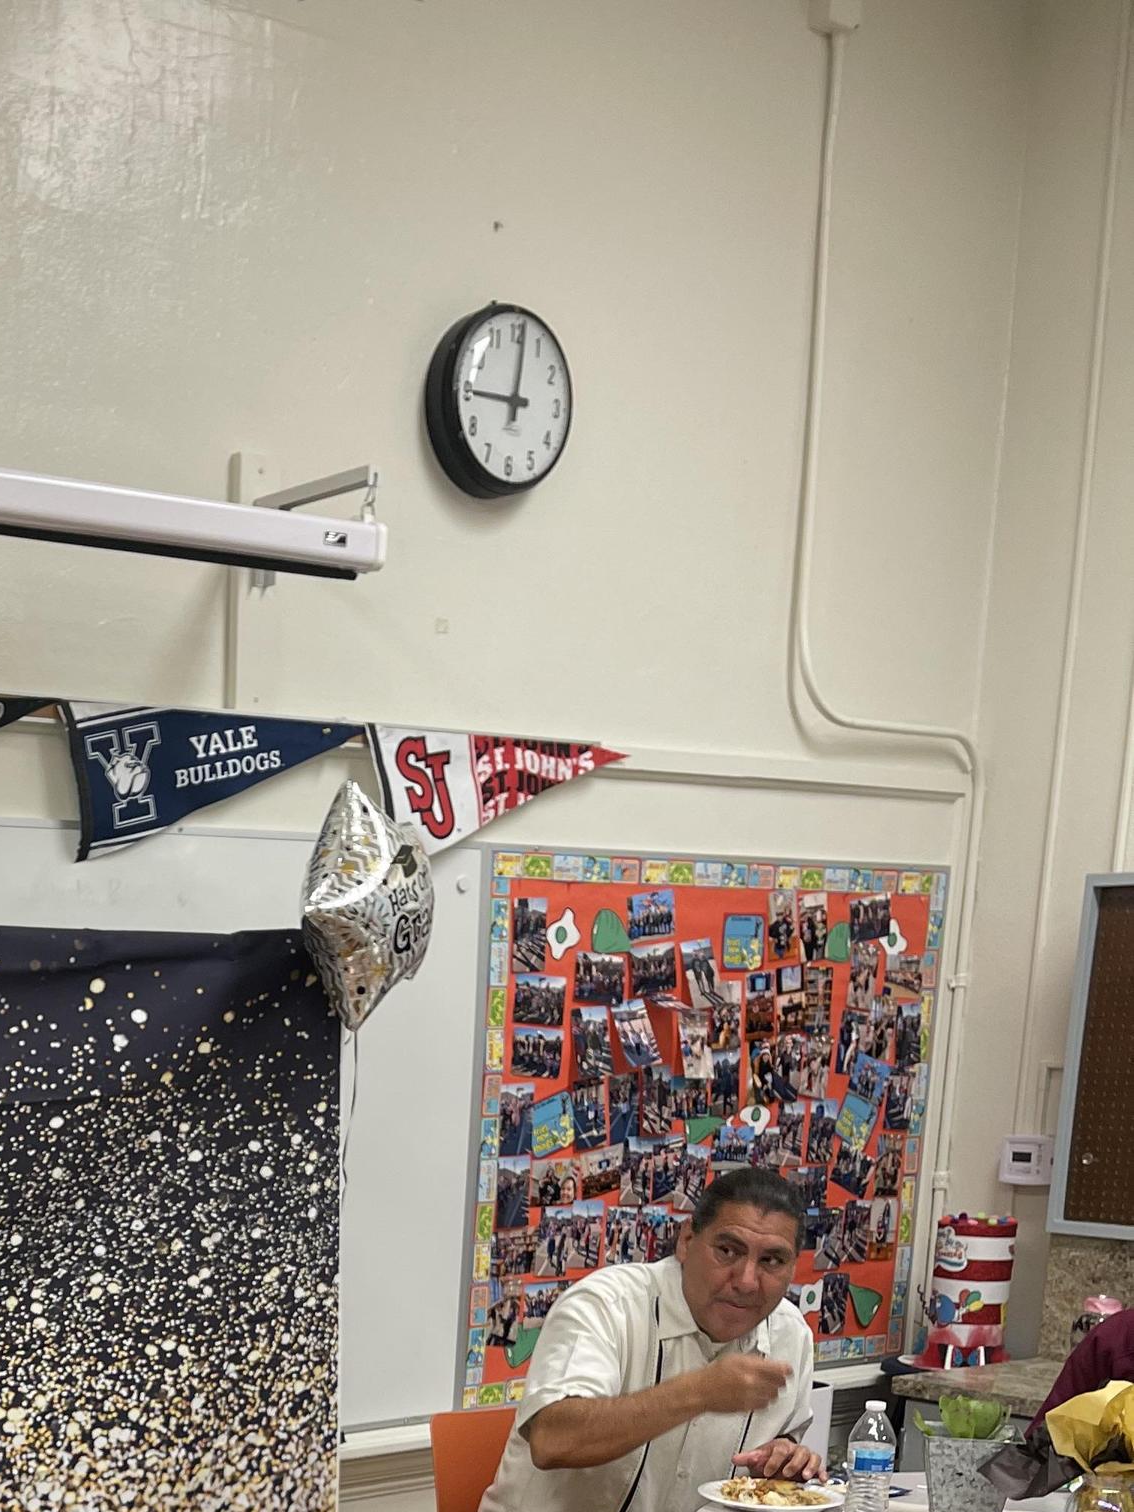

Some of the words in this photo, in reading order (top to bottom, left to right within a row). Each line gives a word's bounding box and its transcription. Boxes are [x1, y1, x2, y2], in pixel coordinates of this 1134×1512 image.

[489, 327, 501, 349] 11
[535, 337, 541, 358] 1
[547, 364, 556, 385] 2
[552, 398, 561, 419] 3
[468, 415, 478, 436] 8
[543, 430, 551, 450] 4
[484, 443, 492, 463] 7
[526, 450, 535, 471] 5
[504, 455, 513, 477] 6
[189, 725, 258, 758] YALE
[175, 750, 281, 788] BULLDOGS
[514, 747, 595, 780] JOHN'S
